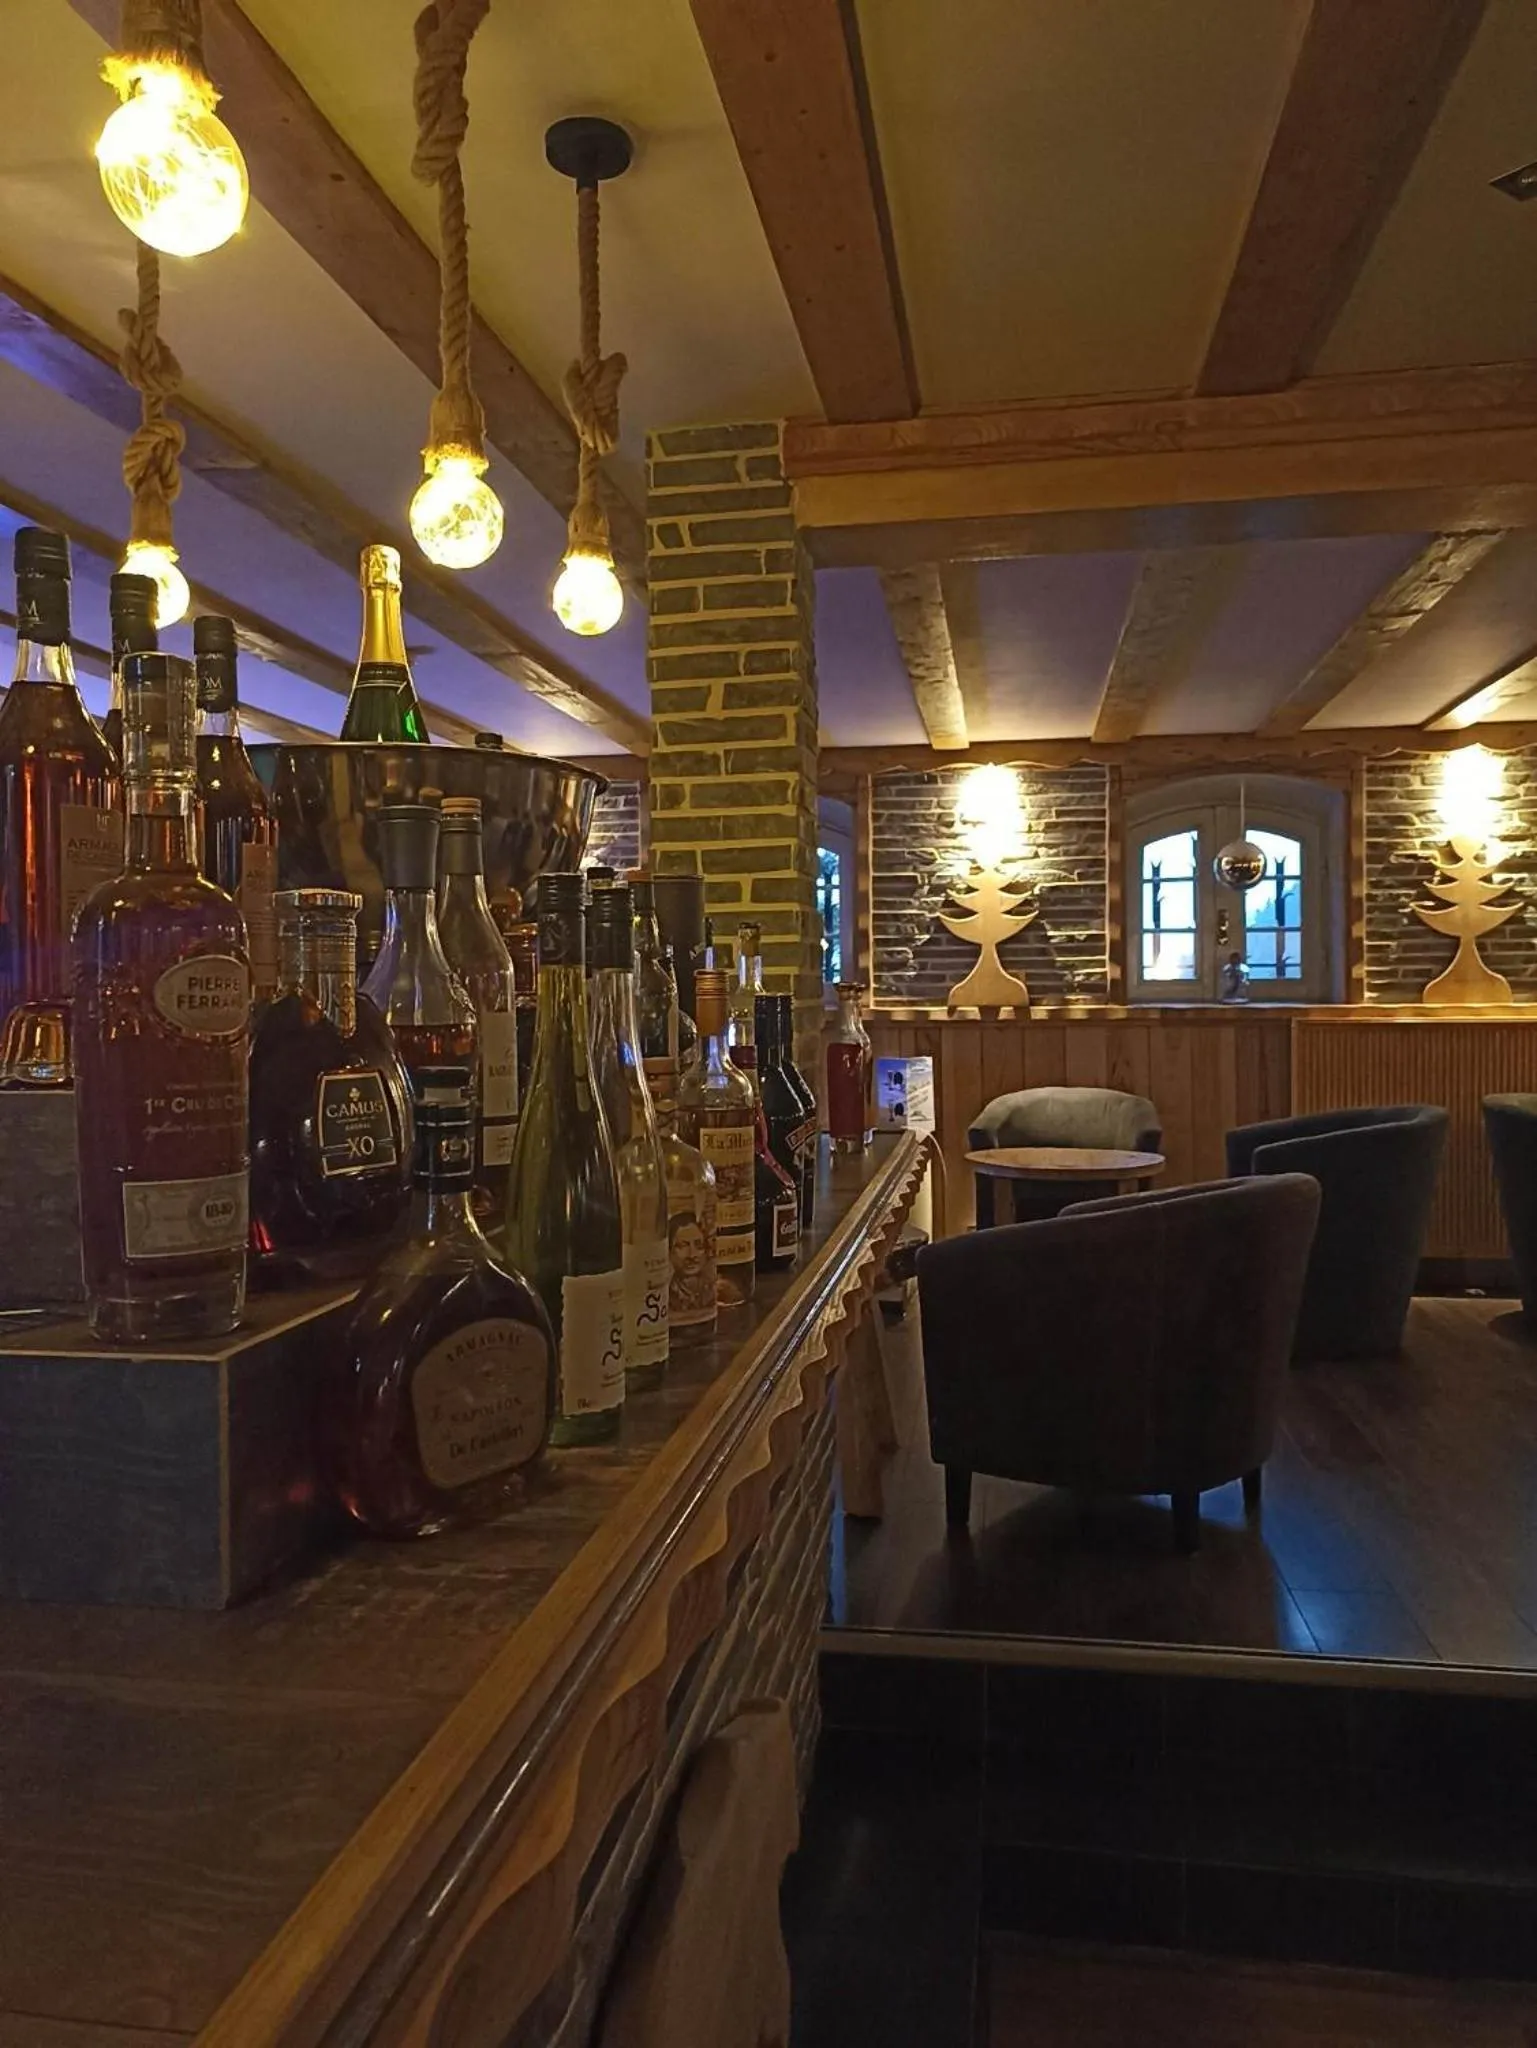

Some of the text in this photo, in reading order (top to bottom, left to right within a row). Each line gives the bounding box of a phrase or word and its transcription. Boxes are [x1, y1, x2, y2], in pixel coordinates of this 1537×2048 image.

[188, 976, 240, 992] PIERRE
[325, 1100, 384, 1119] CAMUS
[346, 1135, 375, 1159] XO
